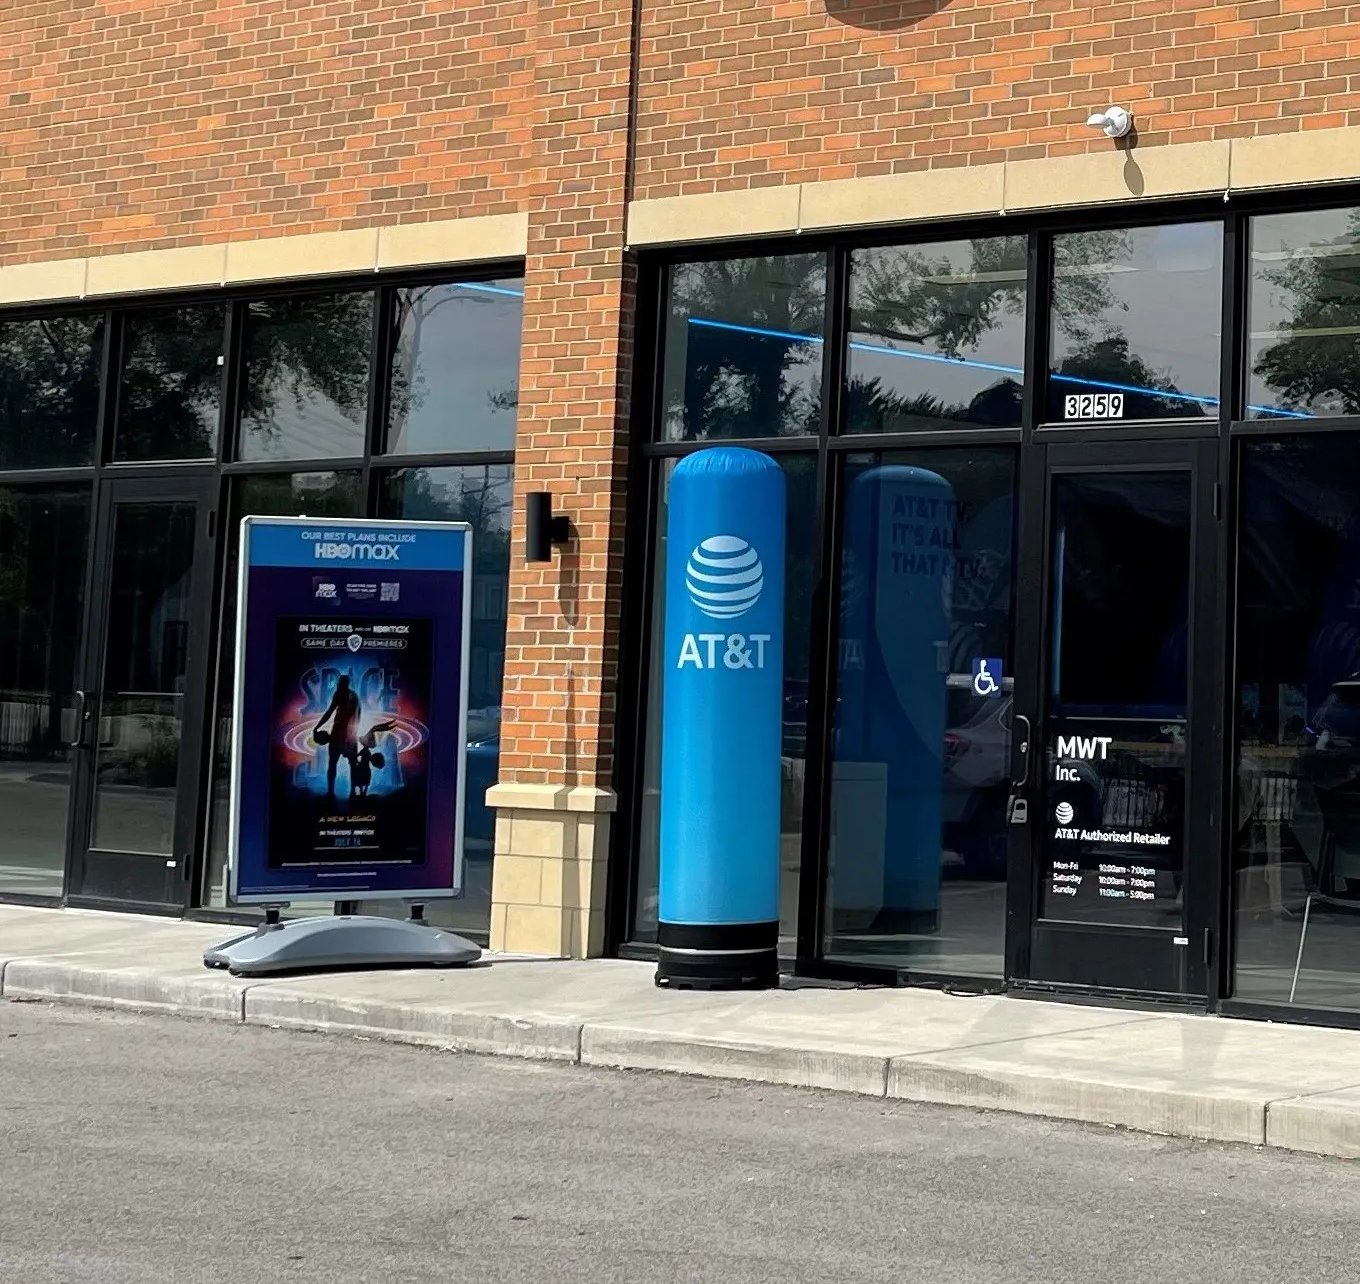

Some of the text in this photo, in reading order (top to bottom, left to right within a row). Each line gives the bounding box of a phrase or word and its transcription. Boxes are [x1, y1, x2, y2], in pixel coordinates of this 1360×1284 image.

[1067, 395, 1121, 416] 3259
[323, 532, 346, 541] BEST
[347, 533, 376, 542] PLANS
[677, 633, 771, 670] AT&T
[1057, 735, 1112, 760] MWT
[1055, 764, 1081, 782] Inc.
[1055, 827, 1171, 845] AT&T Authorized Retailer
[1052, 872, 1083, 885] Saturday
[1052, 884, 1077, 896] Sunday
